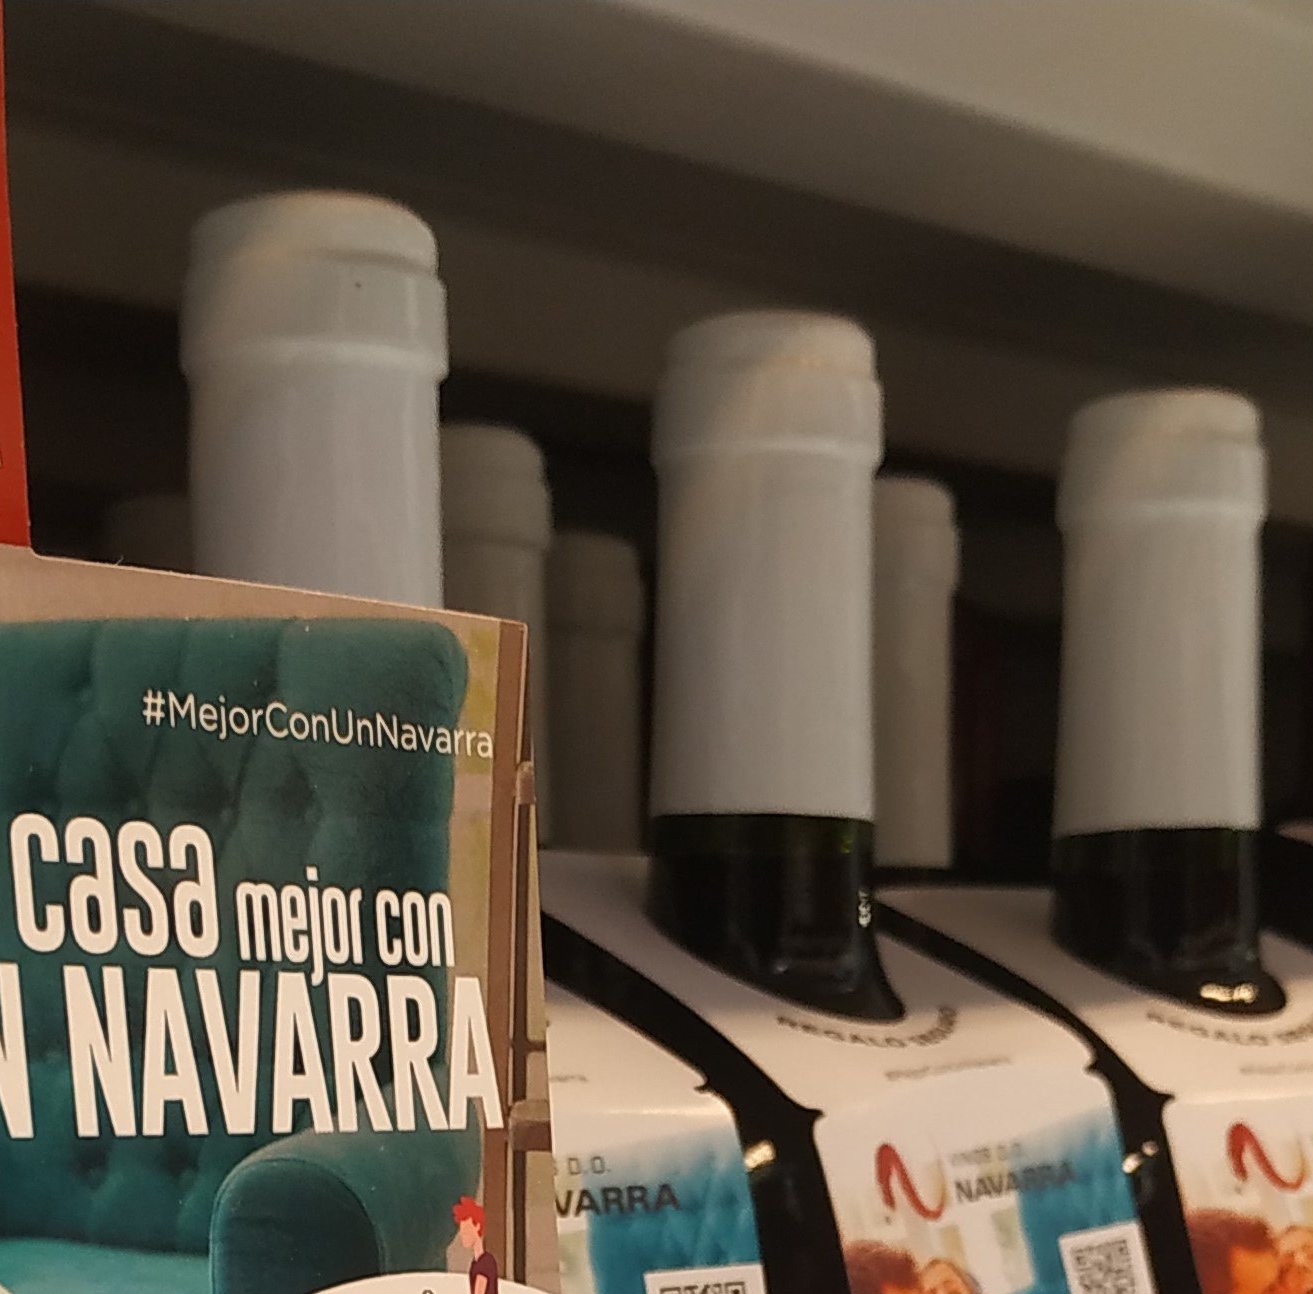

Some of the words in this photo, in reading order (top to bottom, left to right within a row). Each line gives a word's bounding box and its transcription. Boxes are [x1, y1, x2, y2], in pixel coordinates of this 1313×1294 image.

[142, 689, 494, 758] #MejorConUnNavarra
[9, 812, 219, 958] casa
[236, 866, 362, 986] mejor
[376, 889, 455, 968] con
[63, 964, 505, 1137] NAVARRA
